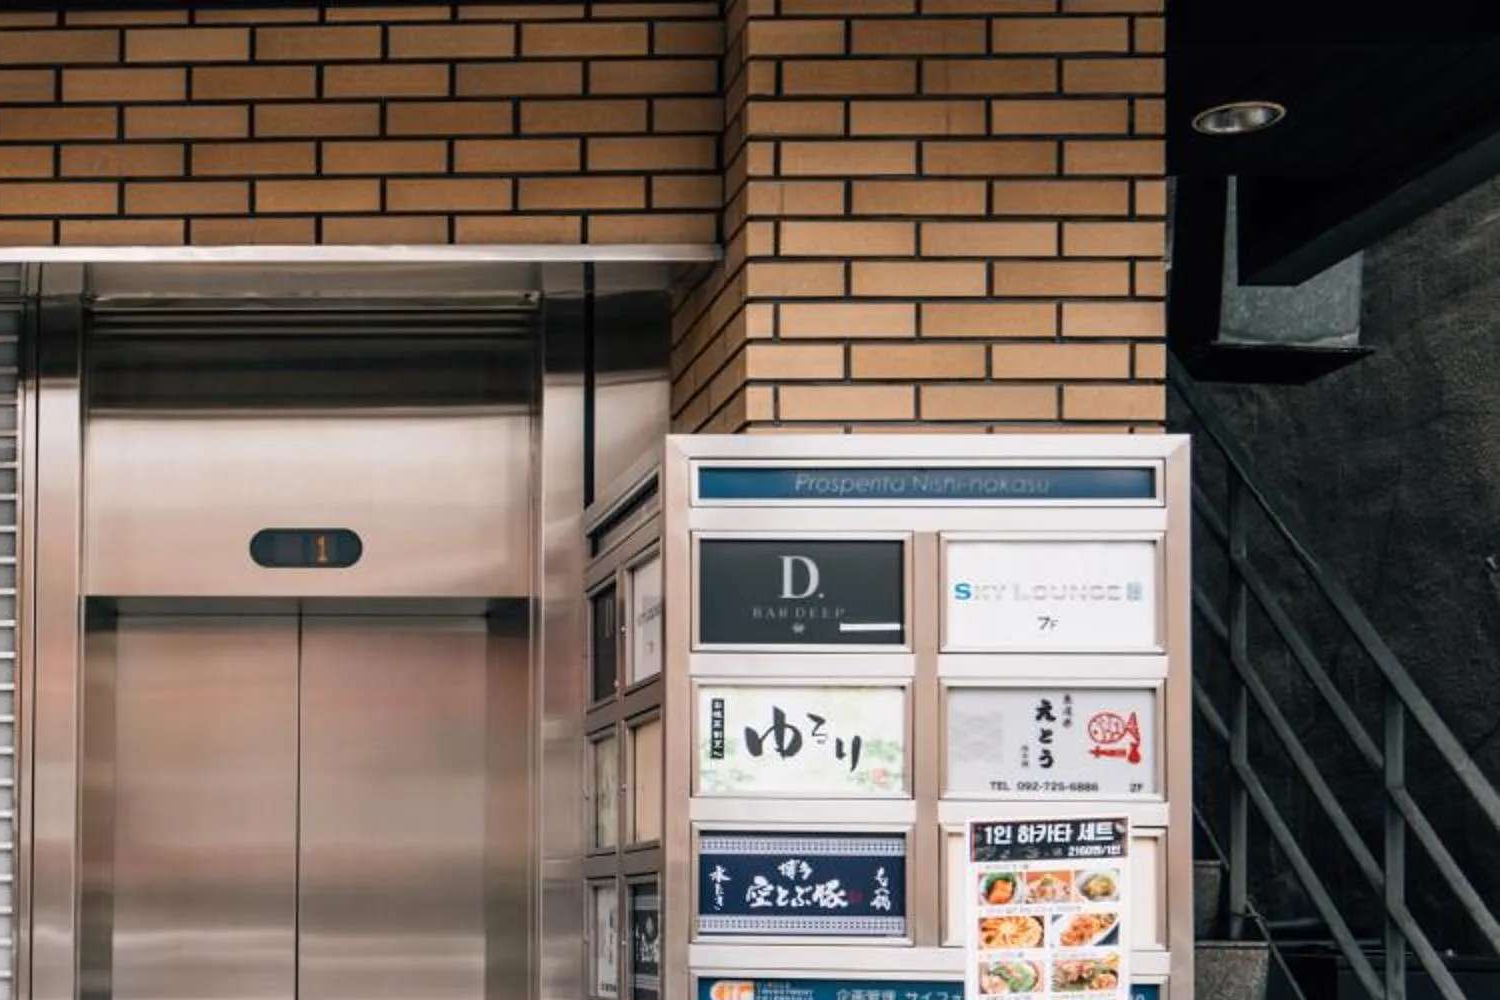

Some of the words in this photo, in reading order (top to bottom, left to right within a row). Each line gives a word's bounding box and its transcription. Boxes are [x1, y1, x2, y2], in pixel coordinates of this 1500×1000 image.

[315, 535, 328, 563] 1
[953, 583, 1007, 600] SKY
[1037, 616, 1058, 630] 7F
[1036, 699, 1056, 769] えとう
[990, 781, 1010, 791] TEL
[984, 825, 1012, 845] 1인
[1018, 823, 1074, 844] 하카타
[1077, 821, 1116, 841] 세트
[777, 859, 813, 881] 博多
[745, 875, 848, 909] 空とぶ豚
